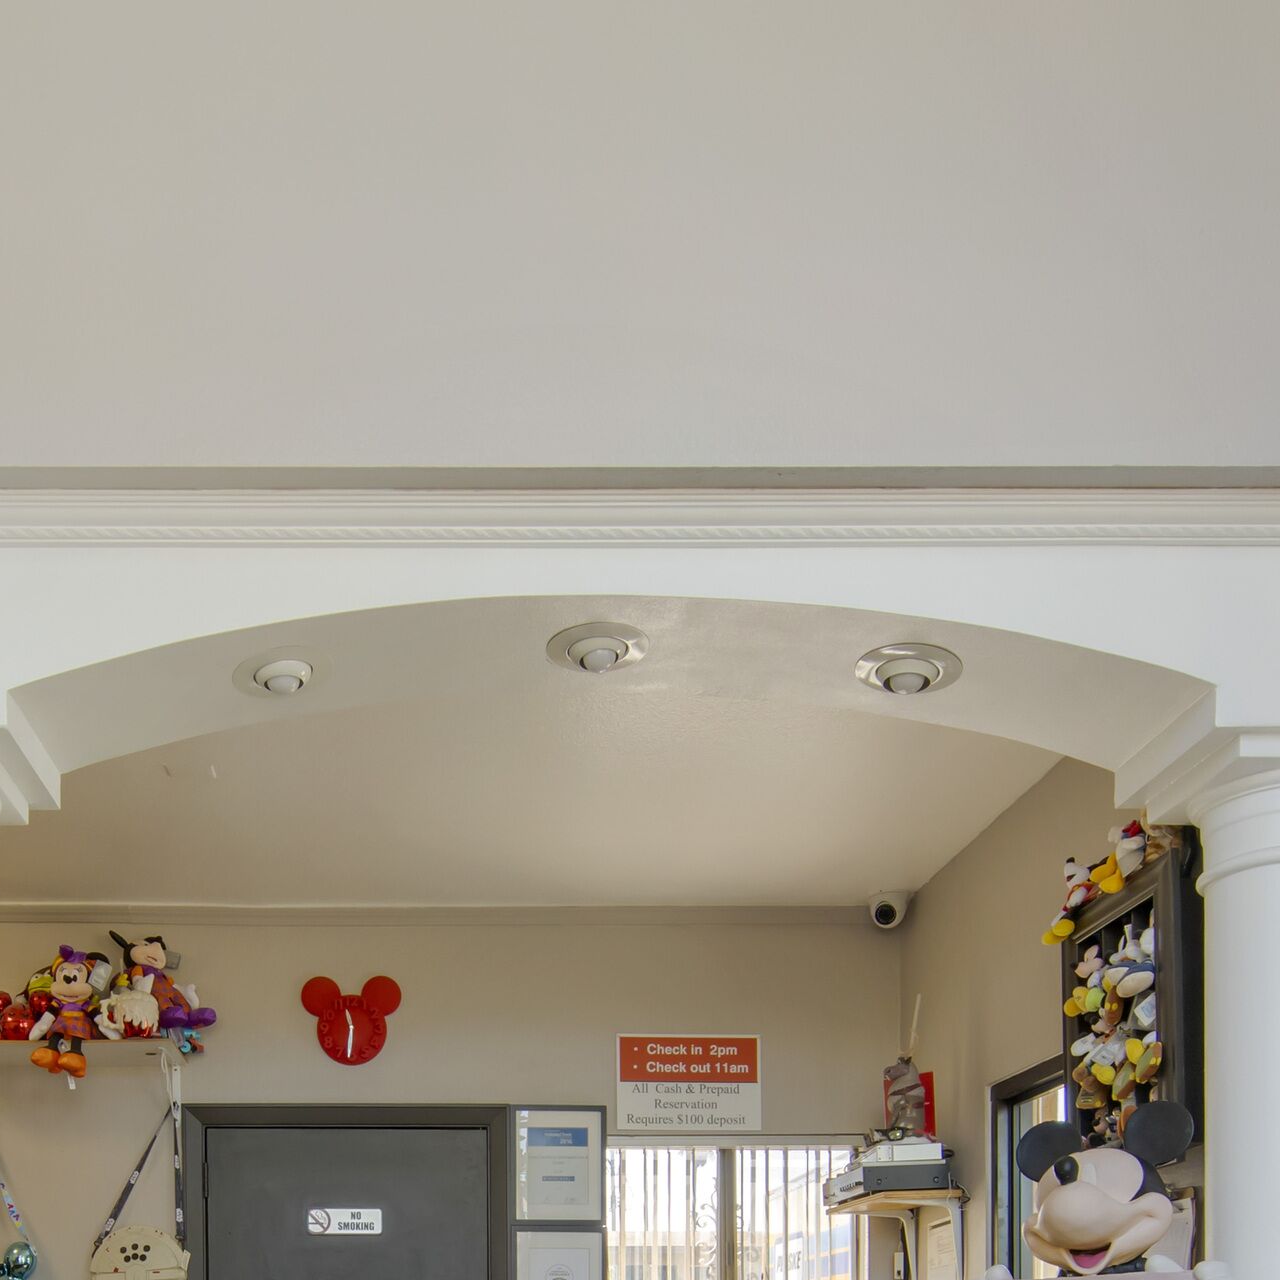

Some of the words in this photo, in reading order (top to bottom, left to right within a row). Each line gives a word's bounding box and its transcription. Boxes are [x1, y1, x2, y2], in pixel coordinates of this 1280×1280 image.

[323, 1009, 335, 1020] 10
[370, 1008, 378, 1018] 2
[320, 1022, 328, 1034] 9
[324, 1037, 333, 1048] 8
[336, 1047, 344, 1057] 7
[647, 1044, 687, 1055] Check
[691, 1045, 702, 1054] in
[710, 1045, 737, 1057] 2pm
[646, 1062, 686, 1072] Check
[691, 1063, 710, 1072] out
[715, 1063, 749, 1073] 11am
[632, 1084, 648, 1093] All
[656, 1084, 682, 1094] Cash
[686, 1084, 695, 1093] &
[700, 1084, 740, 1096] Prepaid
[654, 1099, 717, 1109] Reservation
[627, 1114, 673, 1126] Requires
[677, 1115, 703, 1125] $100
[707, 1115, 745, 1127] deposit
[350, 1211, 361, 1220] NO
[338, 1222, 375, 1231] SMOKING
